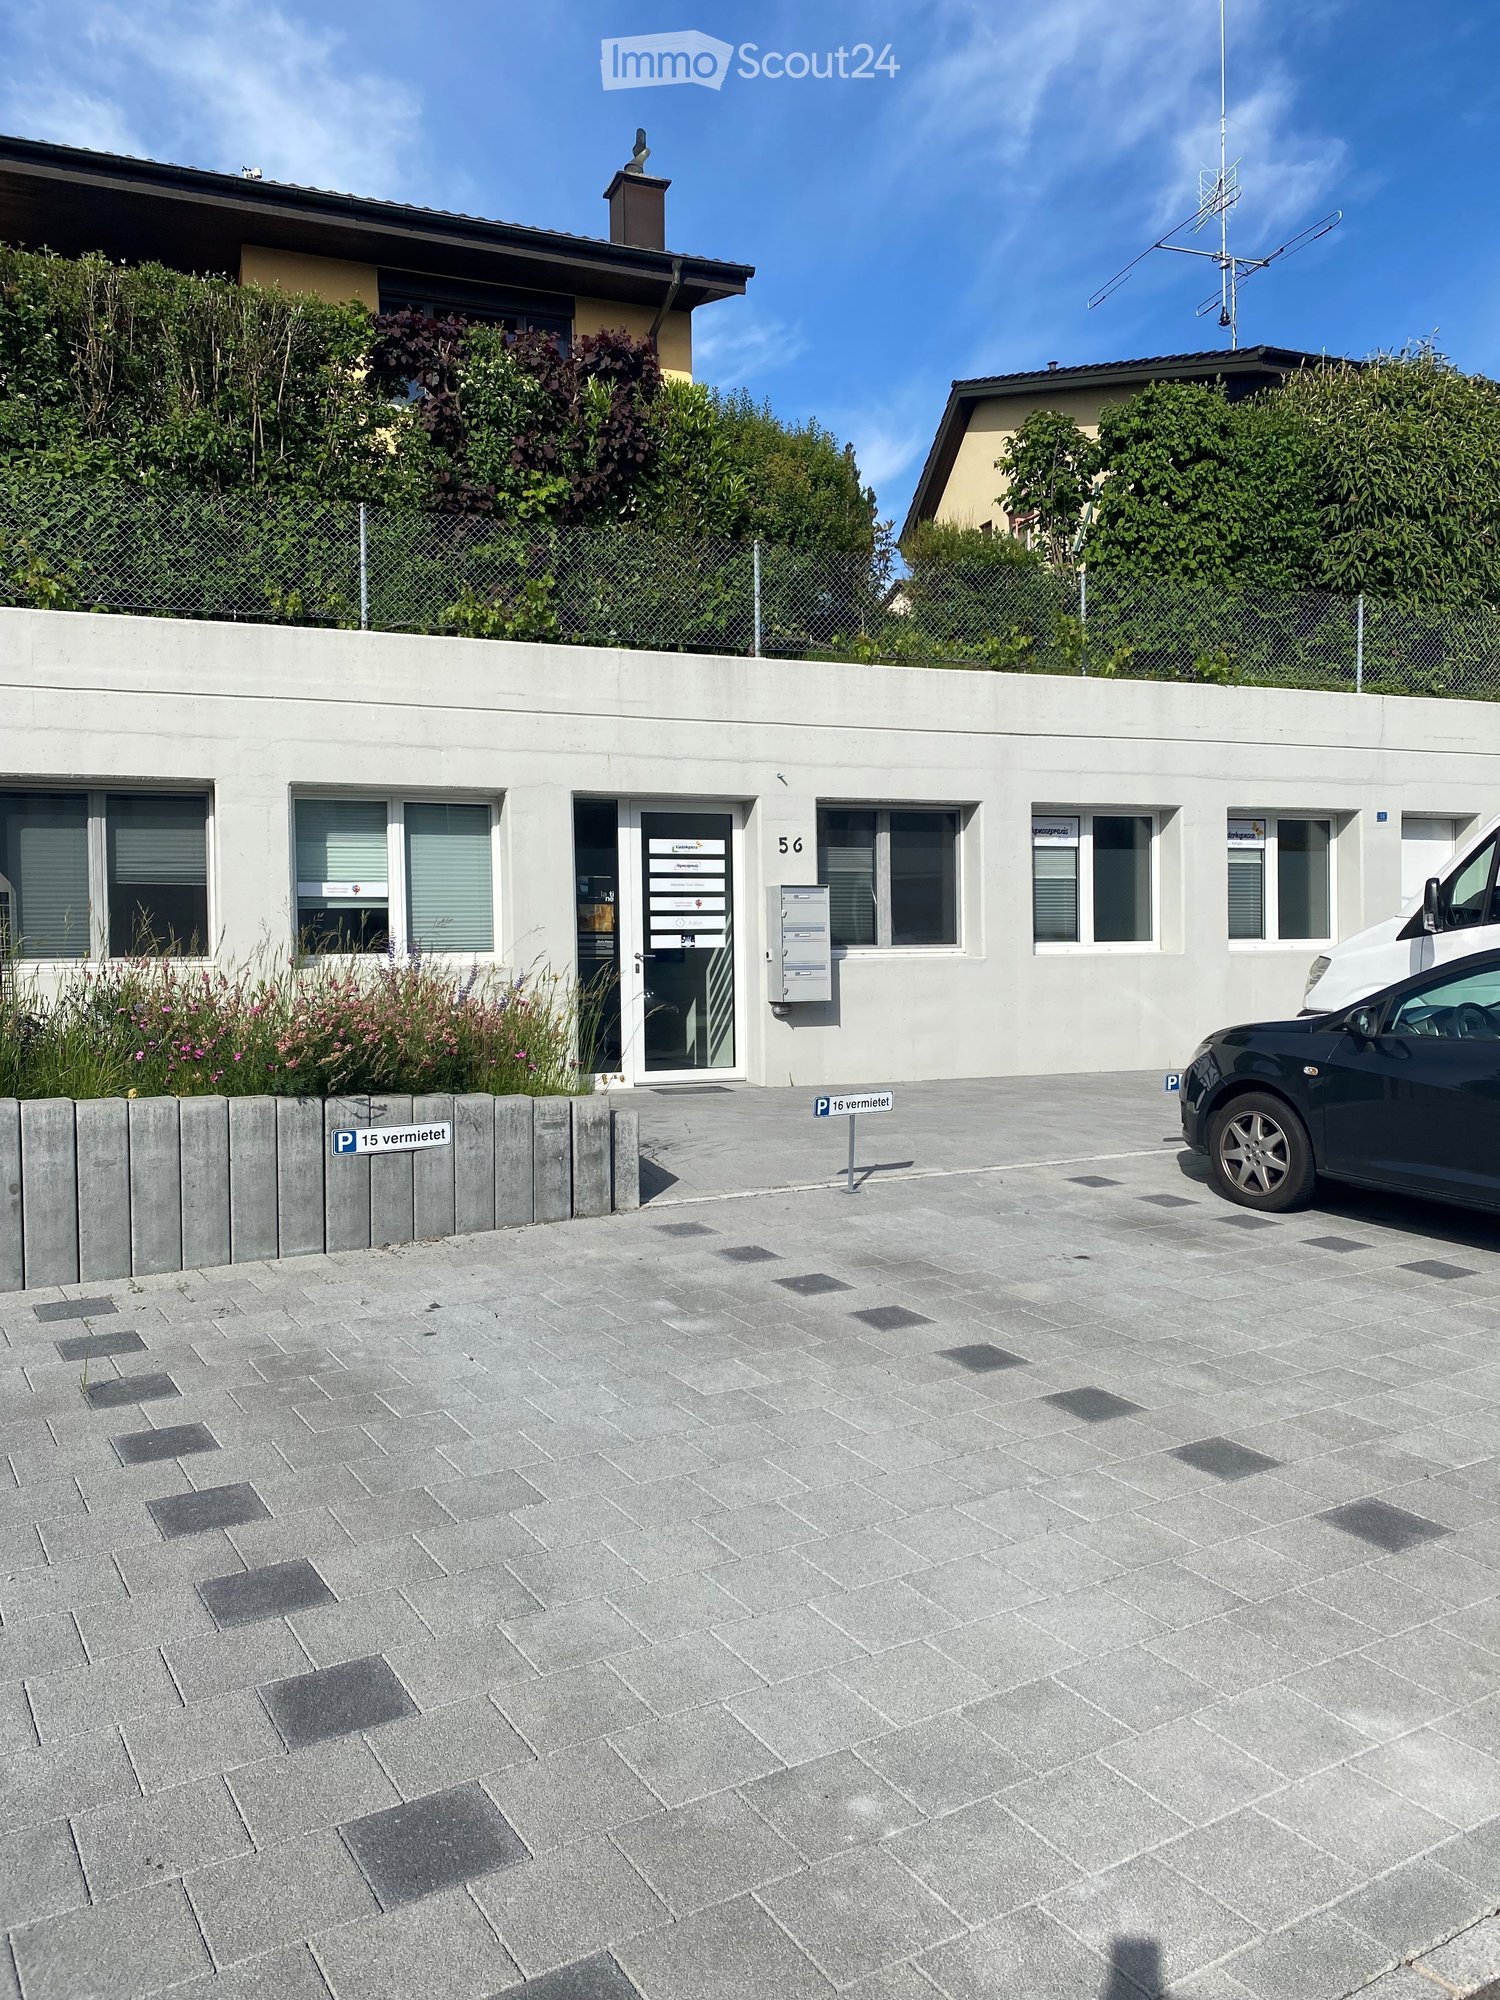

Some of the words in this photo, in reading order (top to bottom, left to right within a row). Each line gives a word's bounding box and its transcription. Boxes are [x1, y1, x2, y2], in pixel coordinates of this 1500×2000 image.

[778, 836, 803, 854] 56
[1167, 1076, 1178, 1090] P
[817, 1099, 828, 1116] P
[833, 1100, 844, 1111] 16
[846, 1097, 890, 1109] vermietet
[338, 1132, 353, 1152] P
[362, 1134, 379, 1147] 15
[382, 1128, 446, 1145] vermietet
